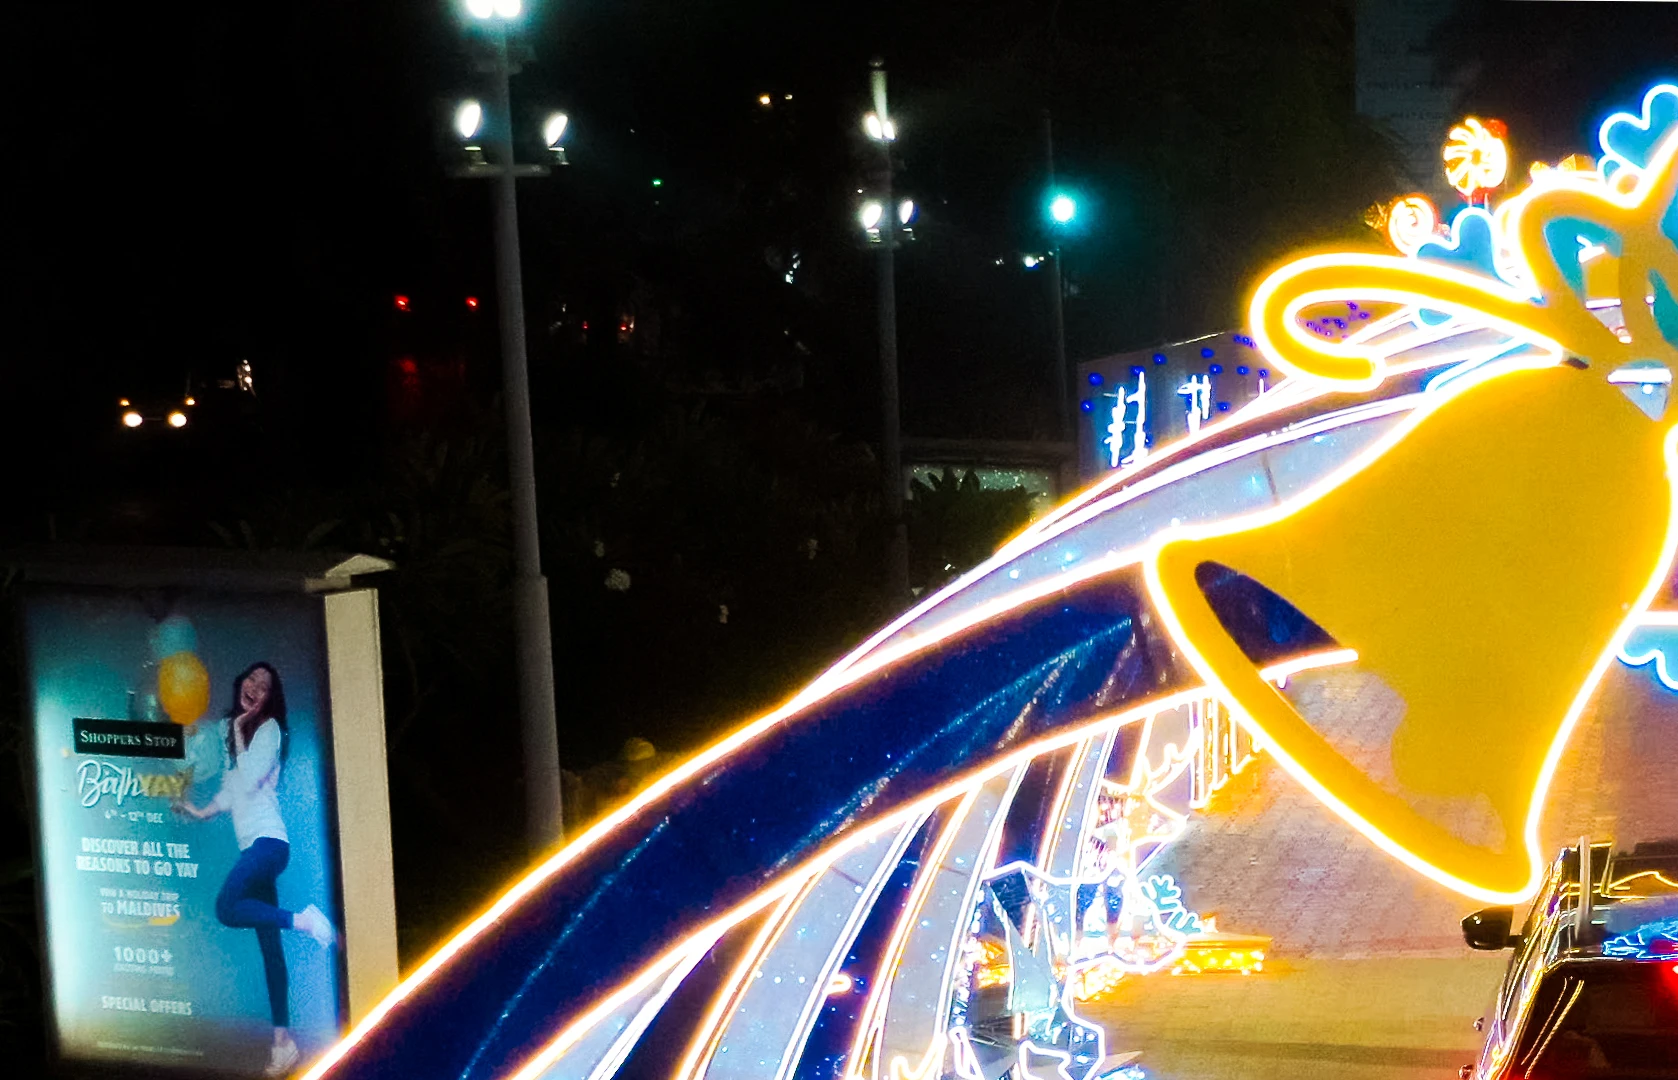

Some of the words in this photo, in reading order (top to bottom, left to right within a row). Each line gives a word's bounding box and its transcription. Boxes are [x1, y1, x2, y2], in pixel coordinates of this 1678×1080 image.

[80, 730, 141, 746] SHOPPERS
[144, 734, 177, 747] STOP
[81, 836, 139, 855] DISCOVER
[142, 841, 164, 857] ALL
[166, 842, 190, 858] THE
[75, 855, 130, 873] REASONS
[133, 860, 150, 875] TO
[154, 861, 172, 876] GO
[175, 862, 199, 878] YAY
[101, 902, 114, 914] TO
[117, 900, 180, 917] MALDIVES
[114, 946, 173, 964] 1000+
[101, 995, 147, 1012] SPECIAL
[149, 999, 193, 1016] OFFERS
